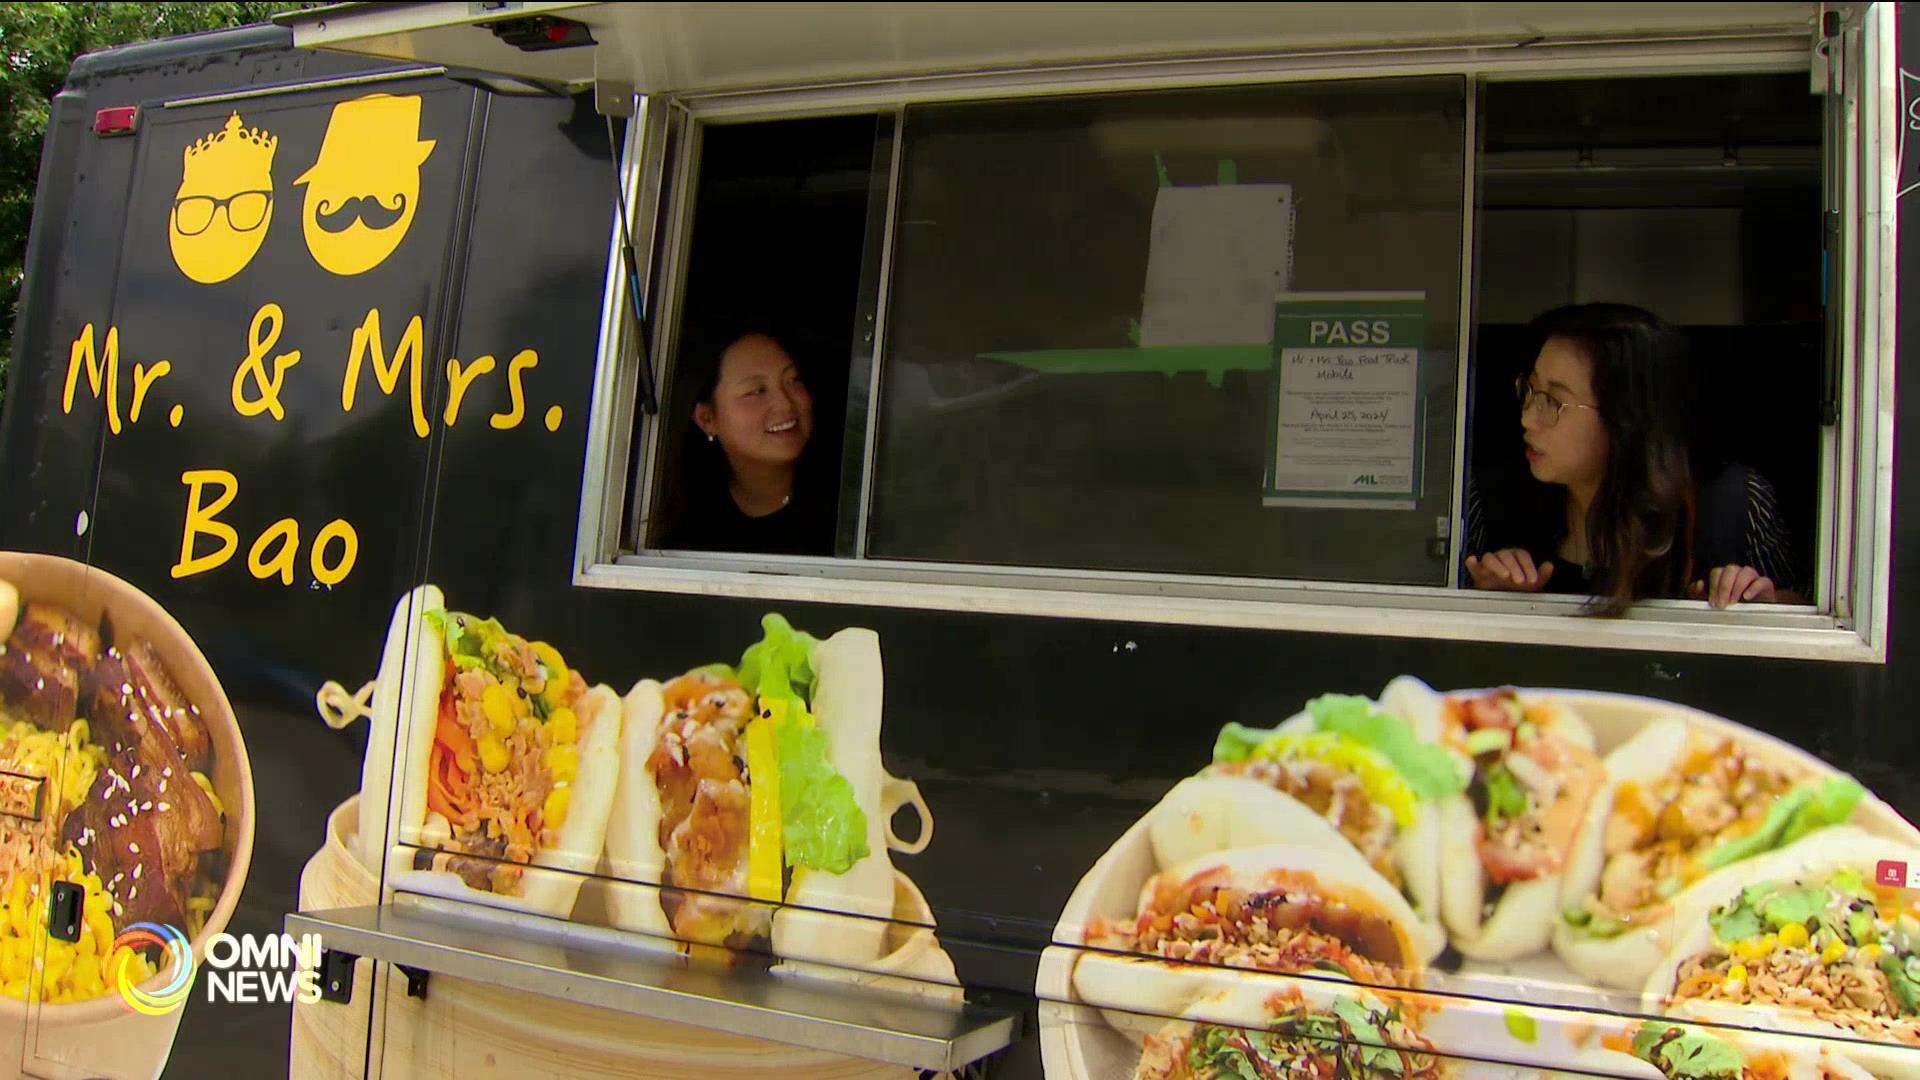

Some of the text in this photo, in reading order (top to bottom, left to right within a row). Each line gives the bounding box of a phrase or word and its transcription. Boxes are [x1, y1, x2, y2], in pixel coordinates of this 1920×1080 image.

[1309, 320, 1391, 345] PASS
[63, 303, 563, 438] Mr. & Mrs.
[1310, 408, 1337, 425] April
[171, 469, 358, 586] Bao
